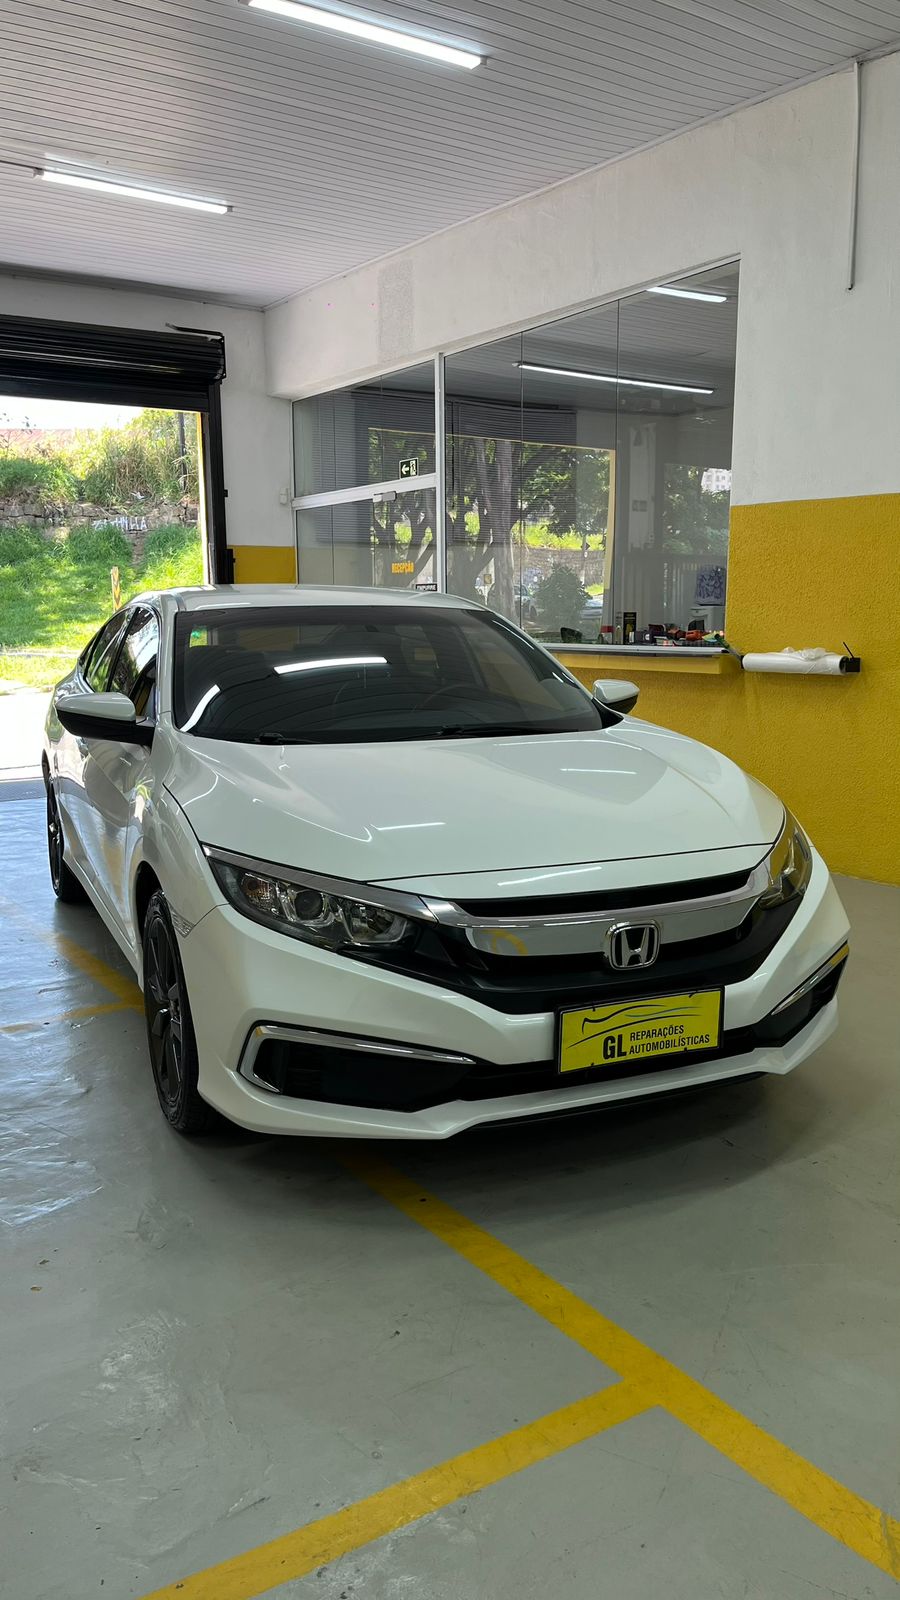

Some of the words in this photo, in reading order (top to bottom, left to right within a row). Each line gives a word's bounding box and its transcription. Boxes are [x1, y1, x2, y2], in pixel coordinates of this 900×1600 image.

[630, 1025, 684, 1042] REPARAÇÕES
[602, 1034, 627, 1060] GL
[629, 1034, 710, 1055] AUTOMOBILÍSTICAS
